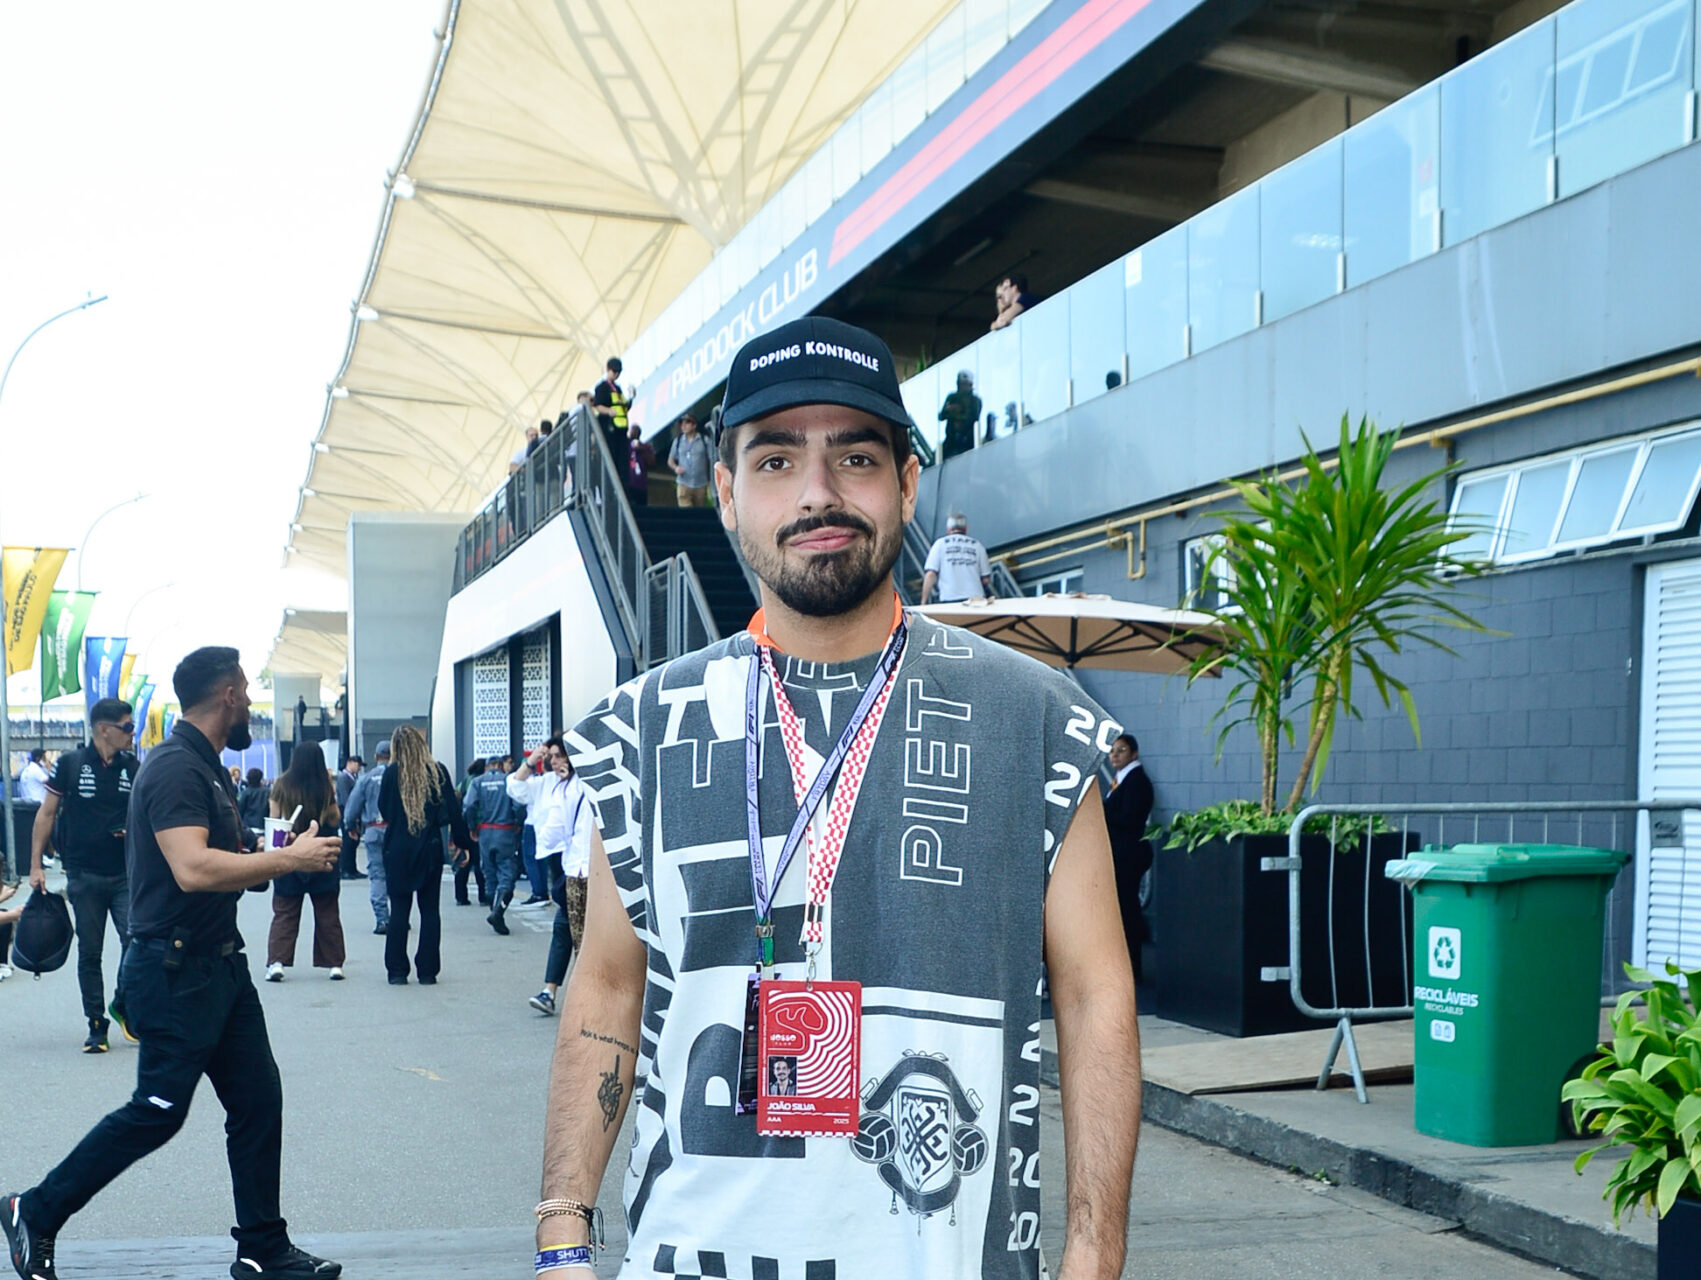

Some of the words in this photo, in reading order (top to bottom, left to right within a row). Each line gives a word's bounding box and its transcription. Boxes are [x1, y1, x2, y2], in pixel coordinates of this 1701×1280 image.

[671, 301, 756, 399] PADDOCK
[758, 247, 818, 325] CLUB
[749, 344, 801, 372] DOPING
[805, 341, 879, 372] KONTROLLE
[811, 770, 832, 801] FRIDAY
[900, 679, 972, 886] PIET
[1414, 985, 1479, 1008] RECICLÁVEIS
[767, 1100, 791, 1111] JOÃO
[792, 1103, 816, 1111] SILVA
